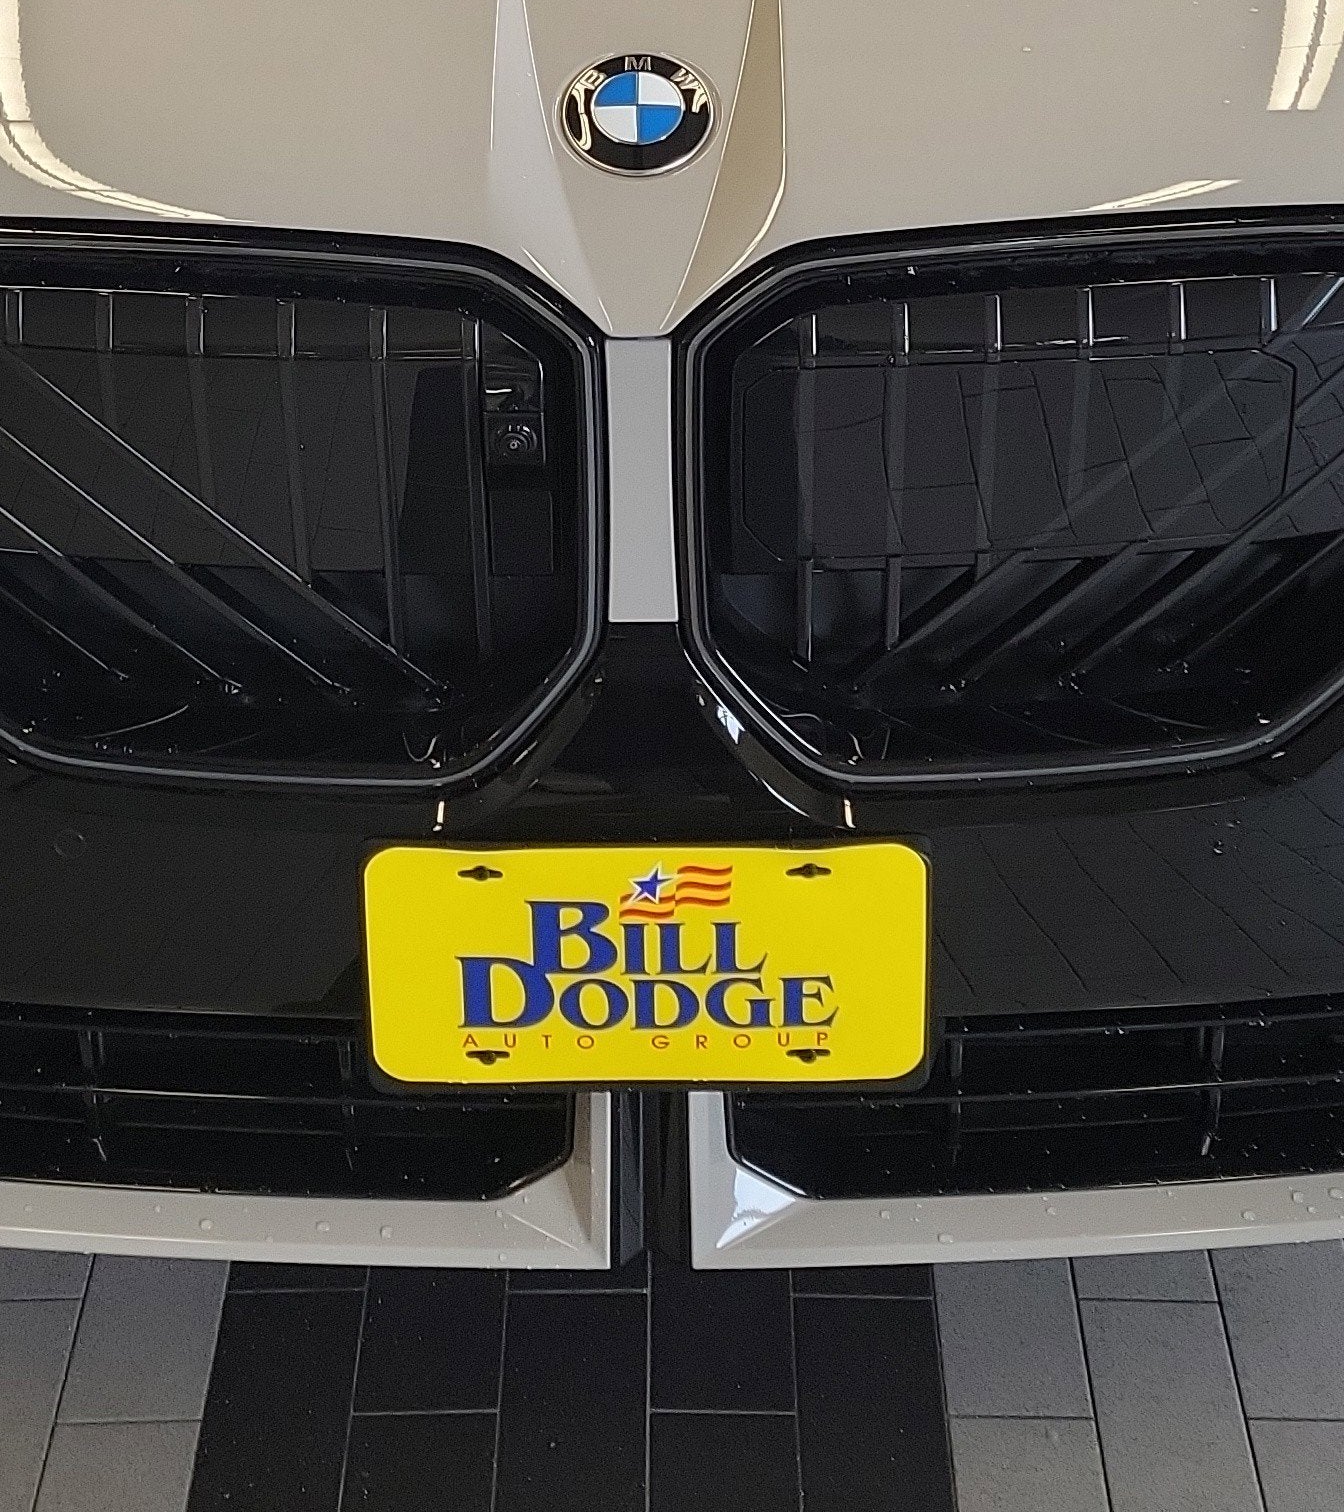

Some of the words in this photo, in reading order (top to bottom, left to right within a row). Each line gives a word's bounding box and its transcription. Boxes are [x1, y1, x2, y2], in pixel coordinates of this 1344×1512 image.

[525, 899, 769, 976] BILL
[454, 955, 840, 1030] DODGE
[462, 1031, 596, 1050] AUTO
[650, 1030, 830, 1050] GROUP
